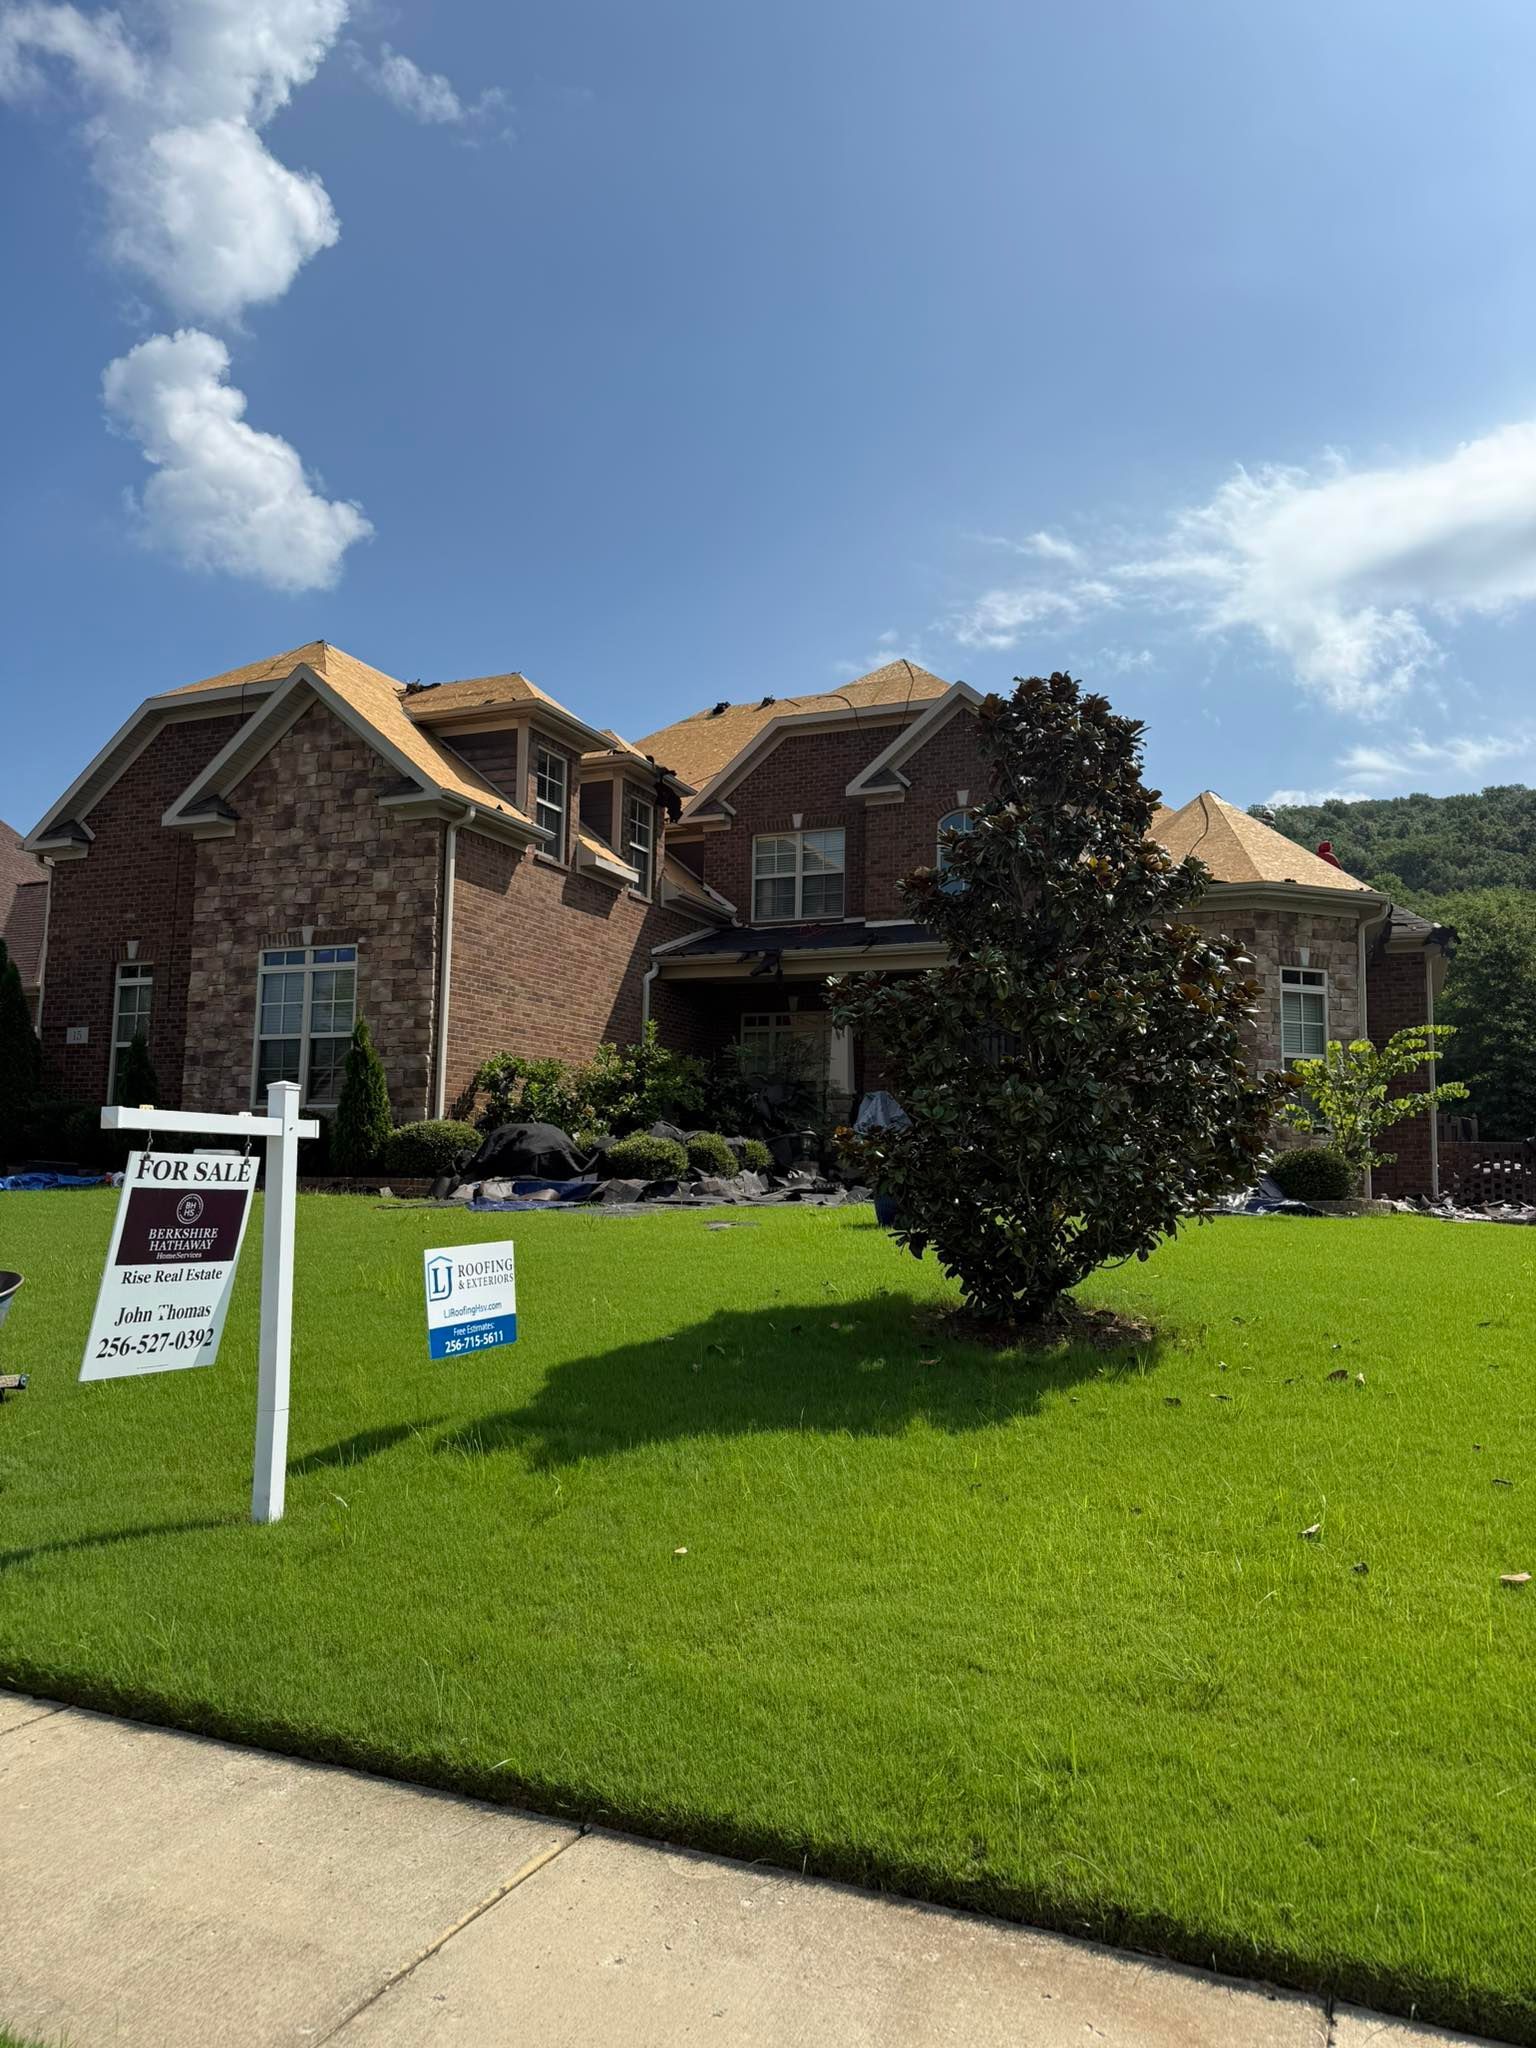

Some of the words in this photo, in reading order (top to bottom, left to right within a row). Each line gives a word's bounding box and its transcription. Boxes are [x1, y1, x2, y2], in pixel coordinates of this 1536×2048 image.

[135, 1159, 188, 1181] FOR
[193, 1161, 252, 1183] SALE
[148, 1227, 219, 1240] BERKSHIRE
[149, 1239, 214, 1252] HATHAWAY
[156, 1251, 202, 1260] HomeServices
[121, 1270, 151, 1285] Rise
[153, 1268, 183, 1284] Real
[185, 1267, 223, 1282] Estate
[458, 1257, 513, 1278] ROOFING
[458, 1280, 465, 1290] &
[467, 1272, 514, 1289] EXTERIORS
[114, 1306, 153, 1327] John
[158, 1303, 212, 1321] Thomas
[443, 1301, 502, 1319] LJRoofingHsv.com
[453, 1327, 466, 1337] Free
[96, 1327, 215, 1359] 256-527-0392
[445, 1330, 503, 1353] 256-715-5611
